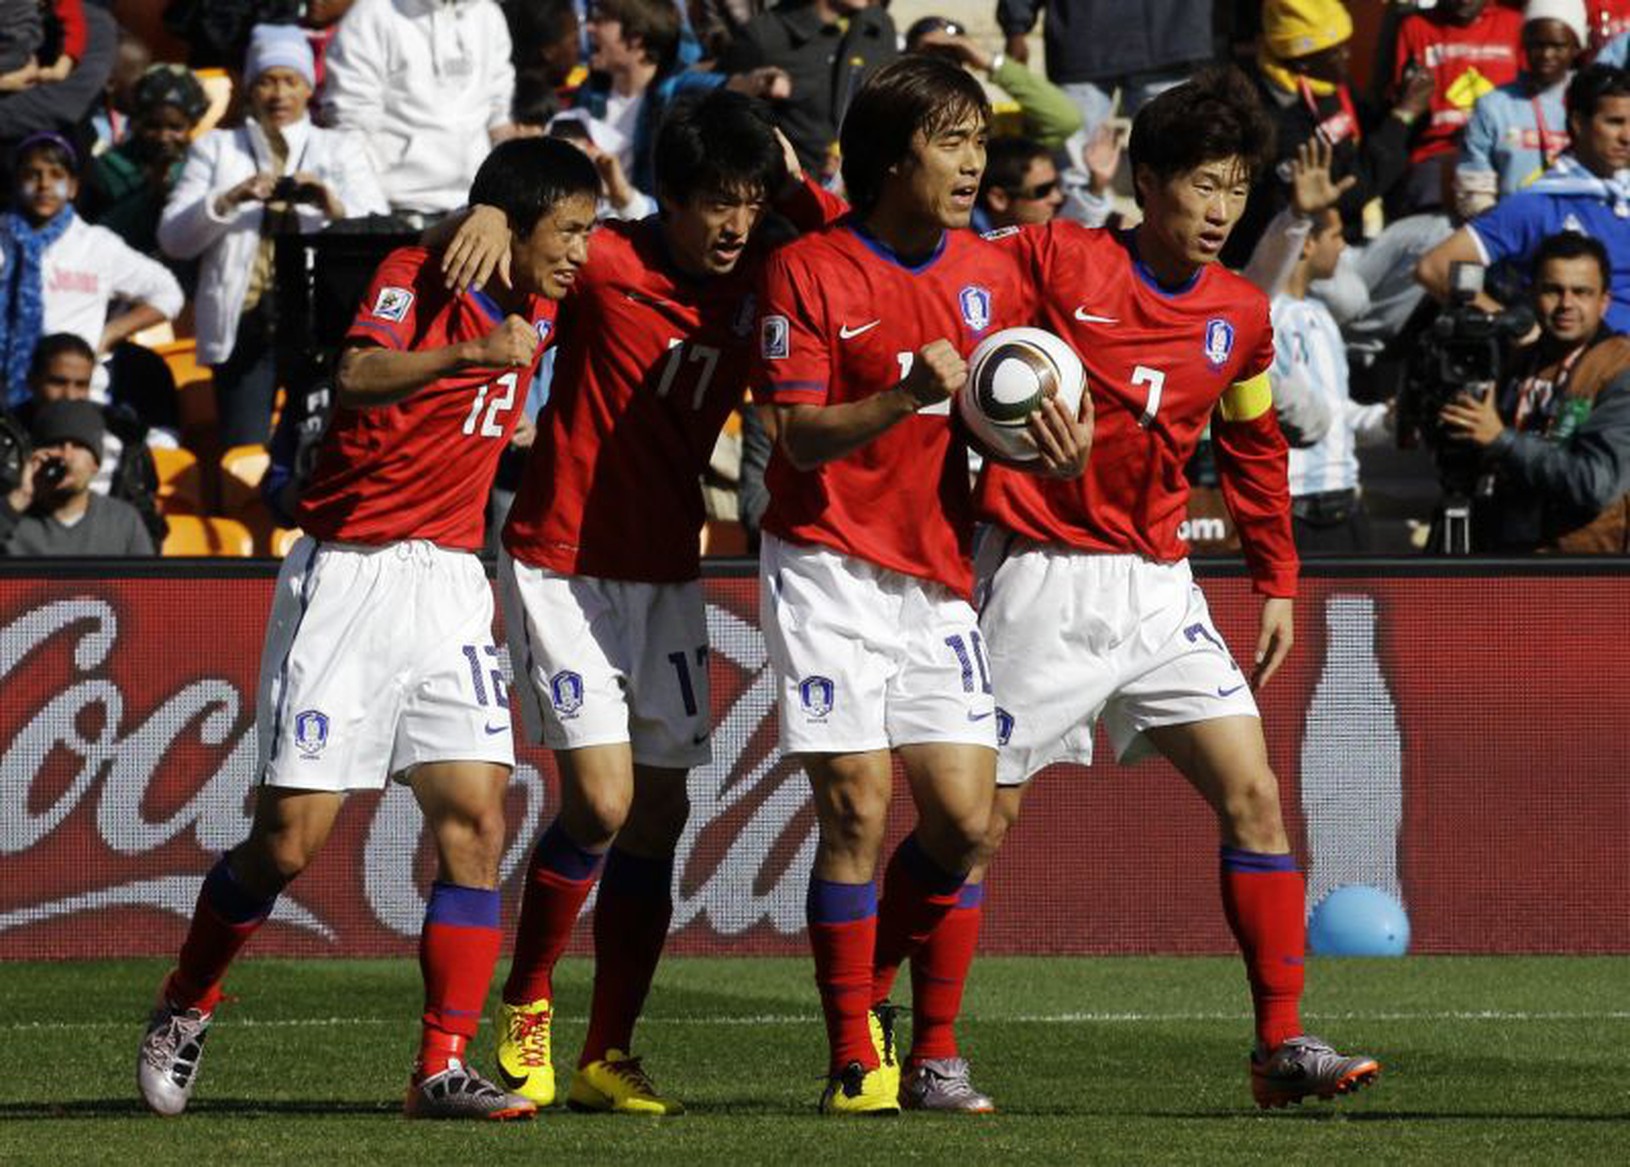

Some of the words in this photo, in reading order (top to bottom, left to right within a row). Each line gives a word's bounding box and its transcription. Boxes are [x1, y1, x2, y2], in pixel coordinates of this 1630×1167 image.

[462, 372, 518, 437] 12
[658, 337, 720, 411] 17
[1131, 365, 1166, 427] 7
[667, 644, 708, 717] 1
